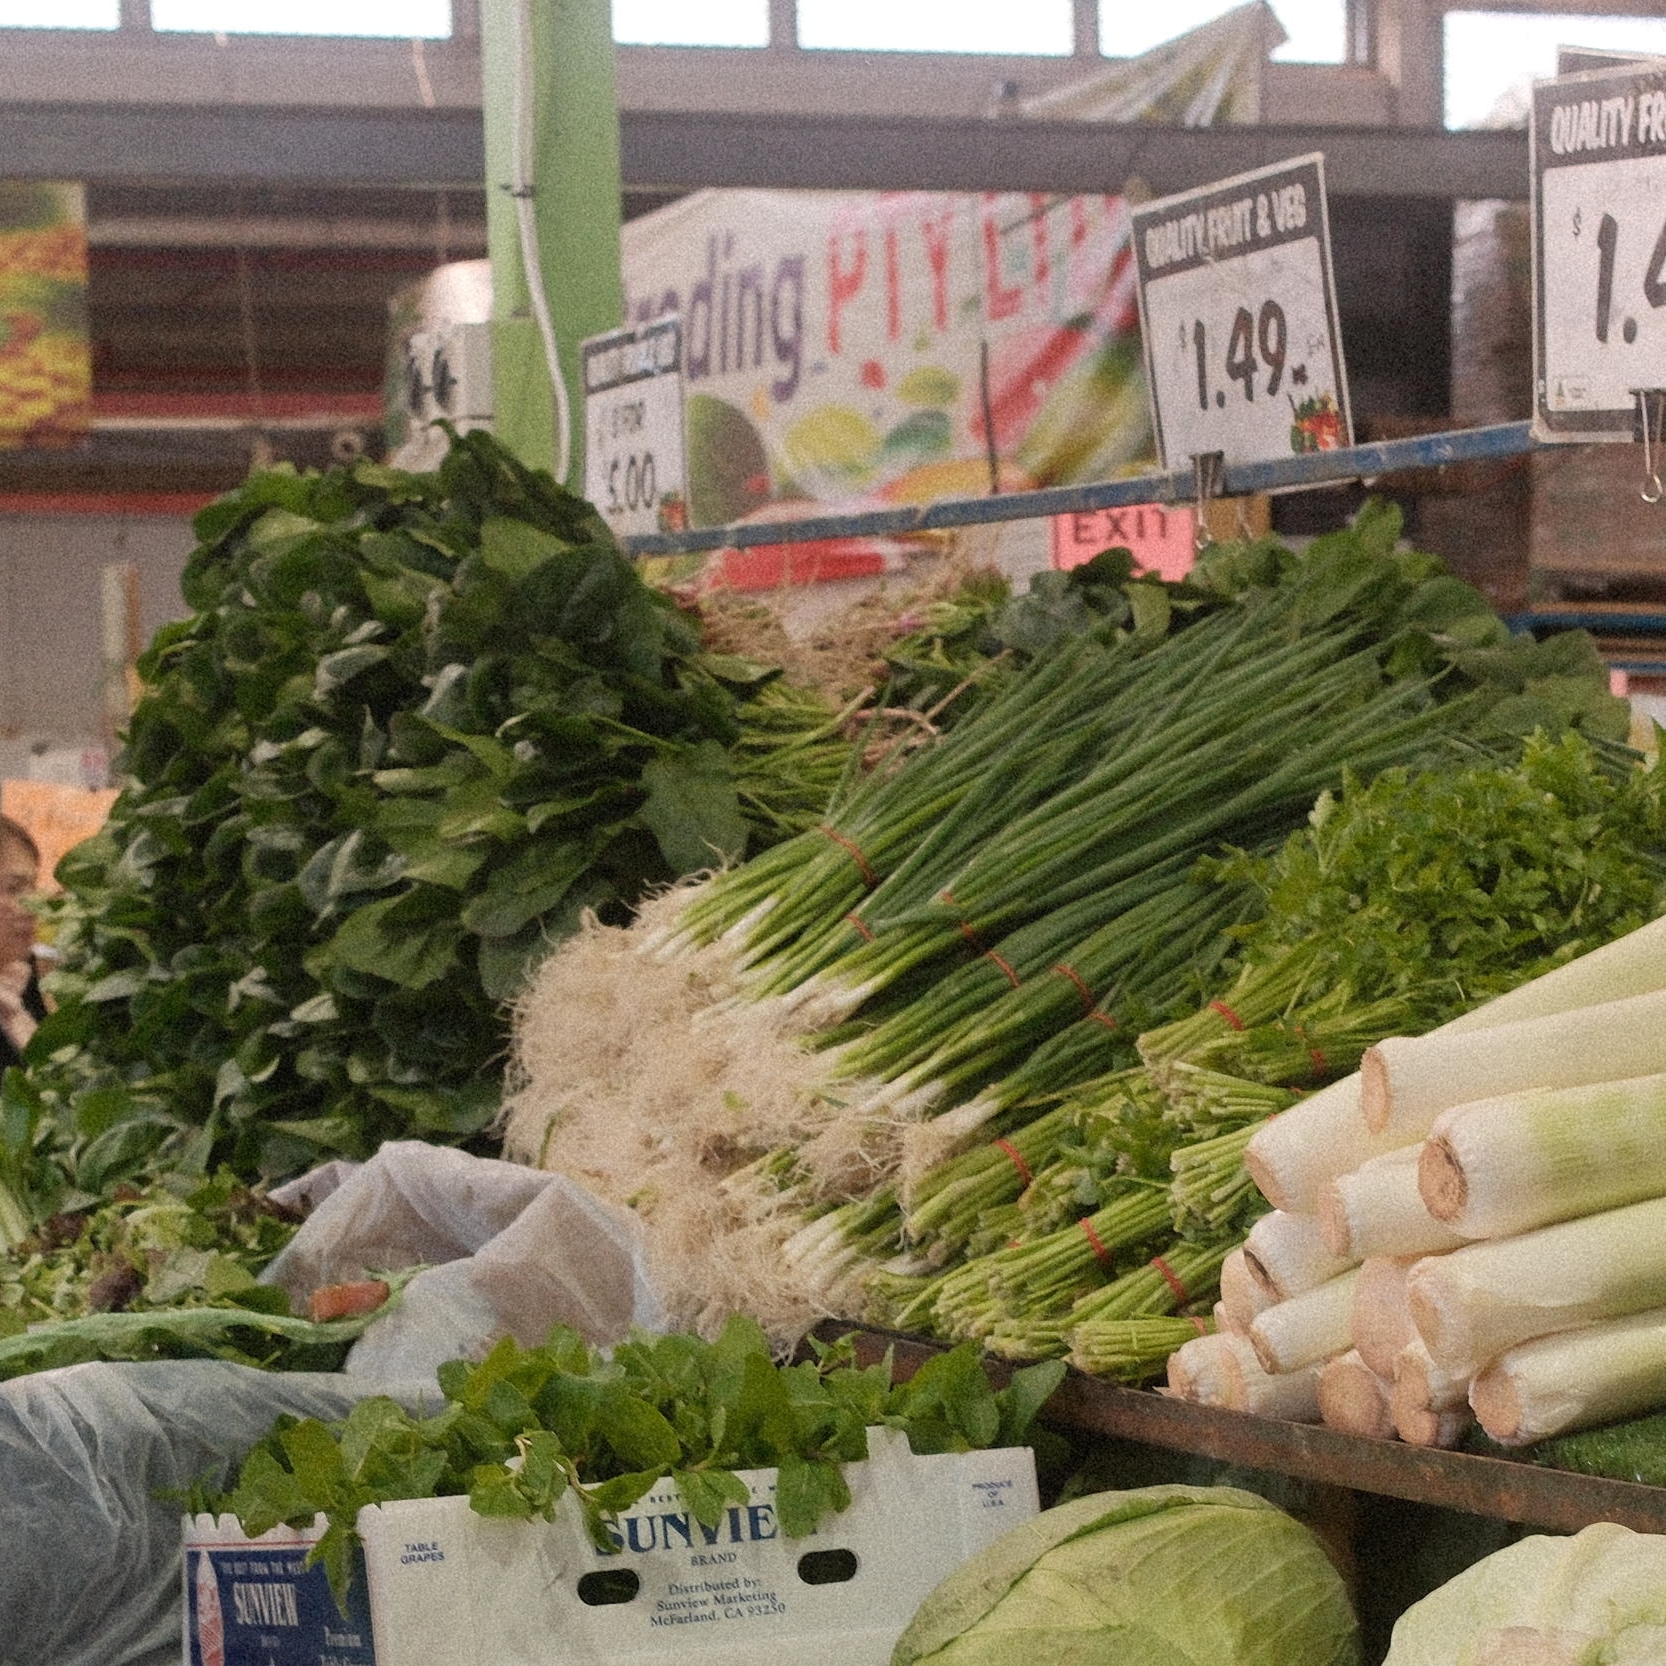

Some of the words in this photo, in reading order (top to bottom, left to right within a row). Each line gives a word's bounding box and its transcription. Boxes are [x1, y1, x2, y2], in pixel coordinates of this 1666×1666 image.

[1551, 99, 1631, 156] QUALITY
[1146, 213, 1206, 269] QUALITY
[1207, 198, 1254, 251] FRUIT
[1272, 183, 1307, 232] VEG
[1073, 508, 1167, 544] EXIT
[595, 1504, 817, 1556] SUNVIE
[405, 1542, 438, 1552] TABLE
[401, 1552, 445, 1565] GRAPES
[690, 1552, 737, 1567] BRAND
[668, 1578, 740, 1596] Distributed
[233, 1582, 299, 1627] SUNVIEW
[657, 1594, 710, 1612] Sunview
[713, 1590, 776, 1608] Marketing
[725, 1606, 743, 1620] CA
